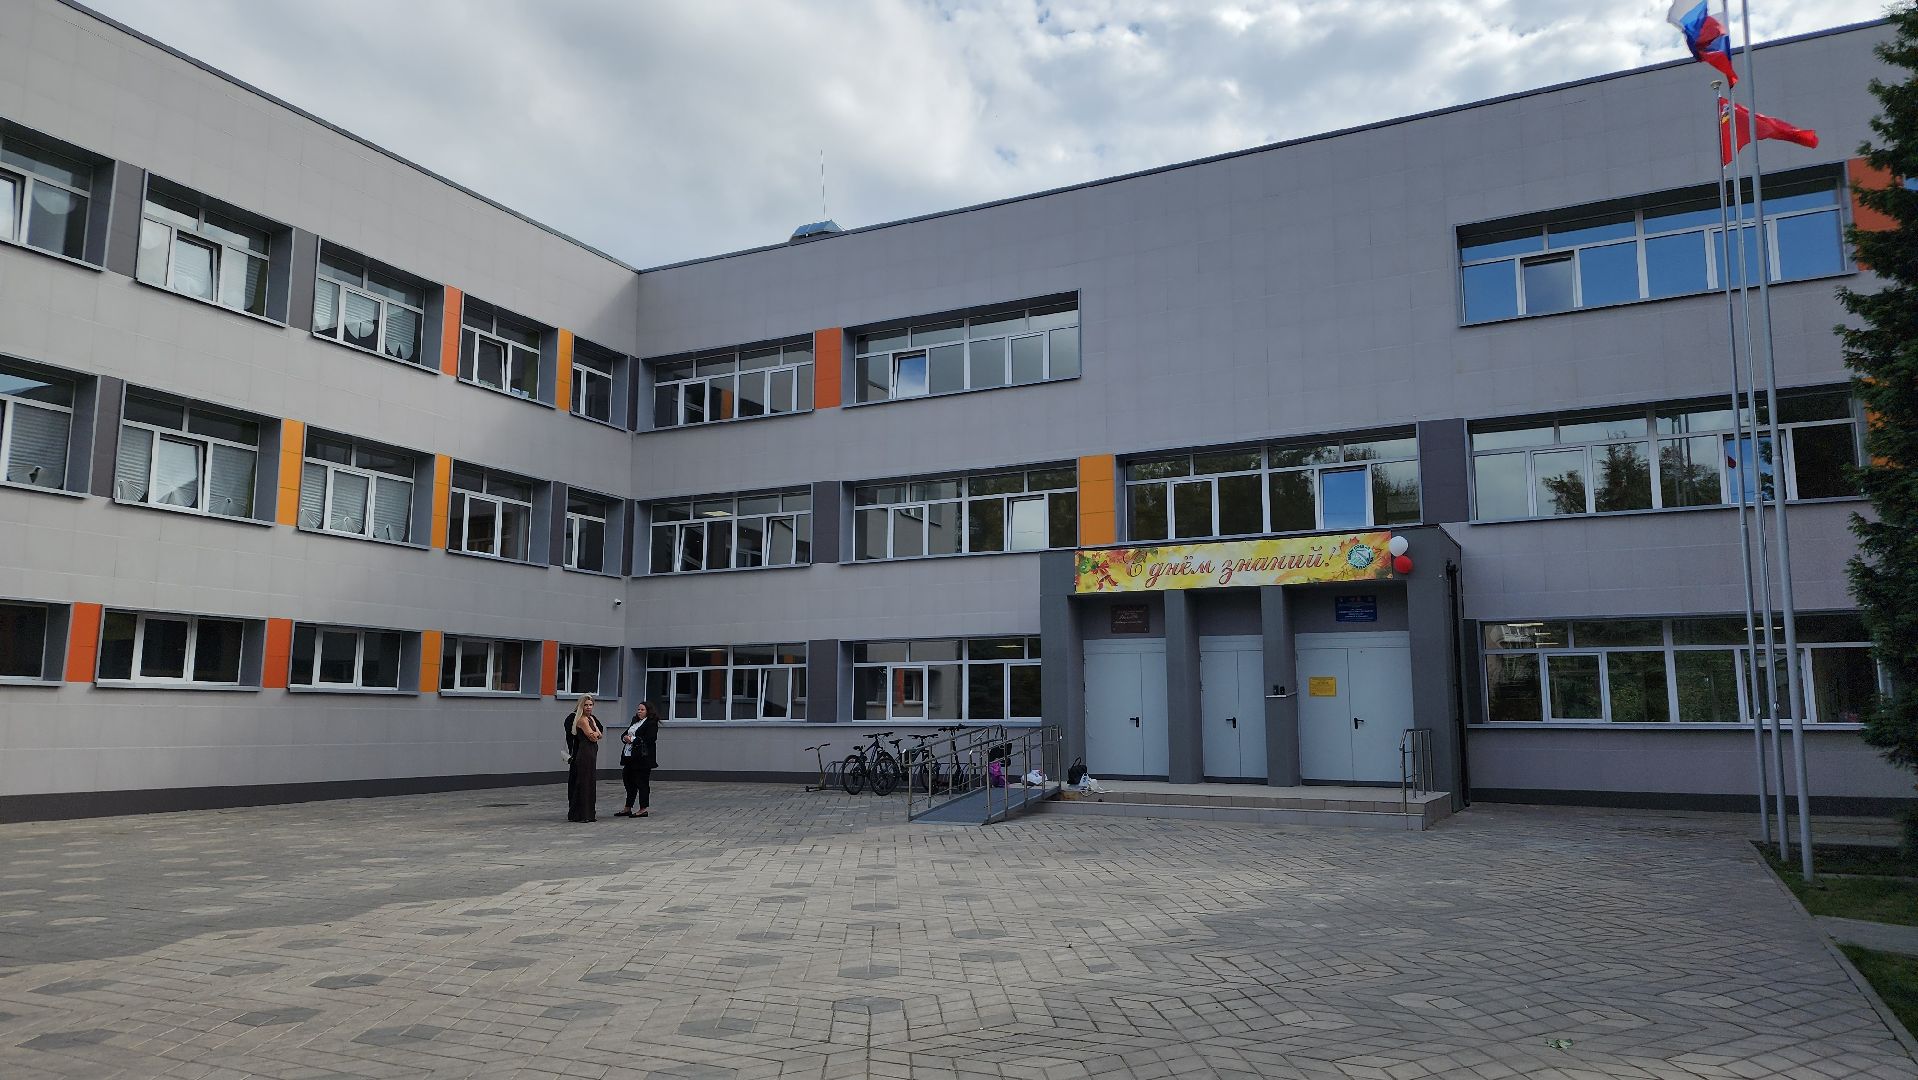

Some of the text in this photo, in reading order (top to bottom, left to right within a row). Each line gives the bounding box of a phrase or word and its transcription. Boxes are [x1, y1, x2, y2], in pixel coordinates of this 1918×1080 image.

[1123, 550, 1147, 577] С
[1145, 555, 1216, 588] днём
[1218, 545, 1337, 585] знаний!
